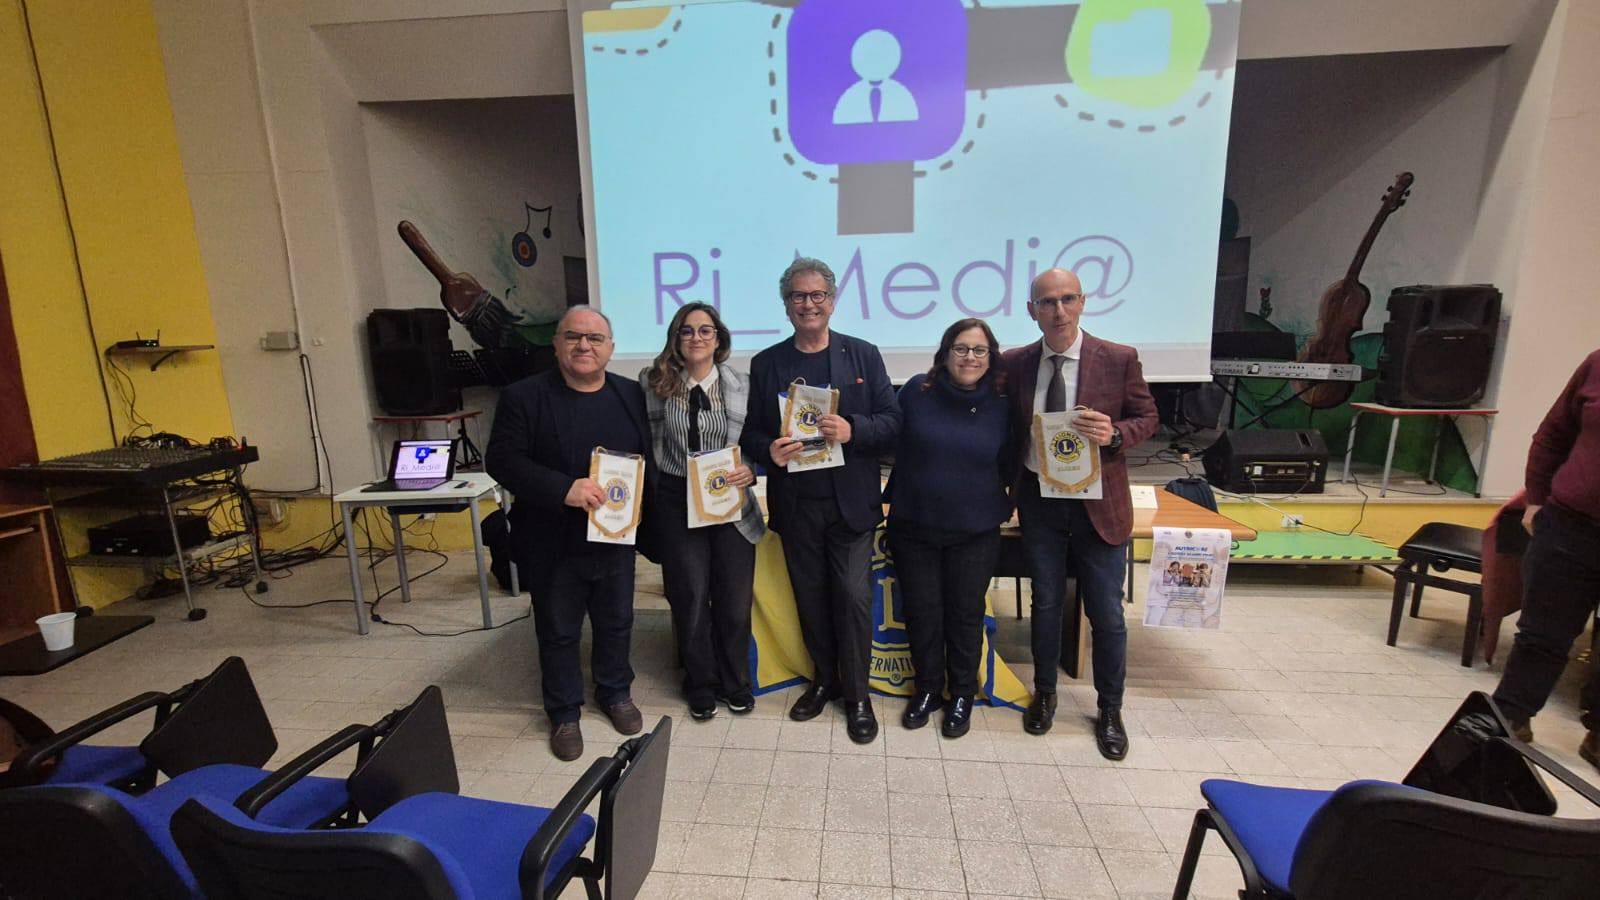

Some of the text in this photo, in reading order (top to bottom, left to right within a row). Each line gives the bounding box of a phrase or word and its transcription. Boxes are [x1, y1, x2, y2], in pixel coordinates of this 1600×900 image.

[806, 413, 815, 424] L
[1063, 441, 1072, 452] L
[716, 479, 723, 488] L
[614, 488, 621, 500] L
[877, 576, 906, 632] L
